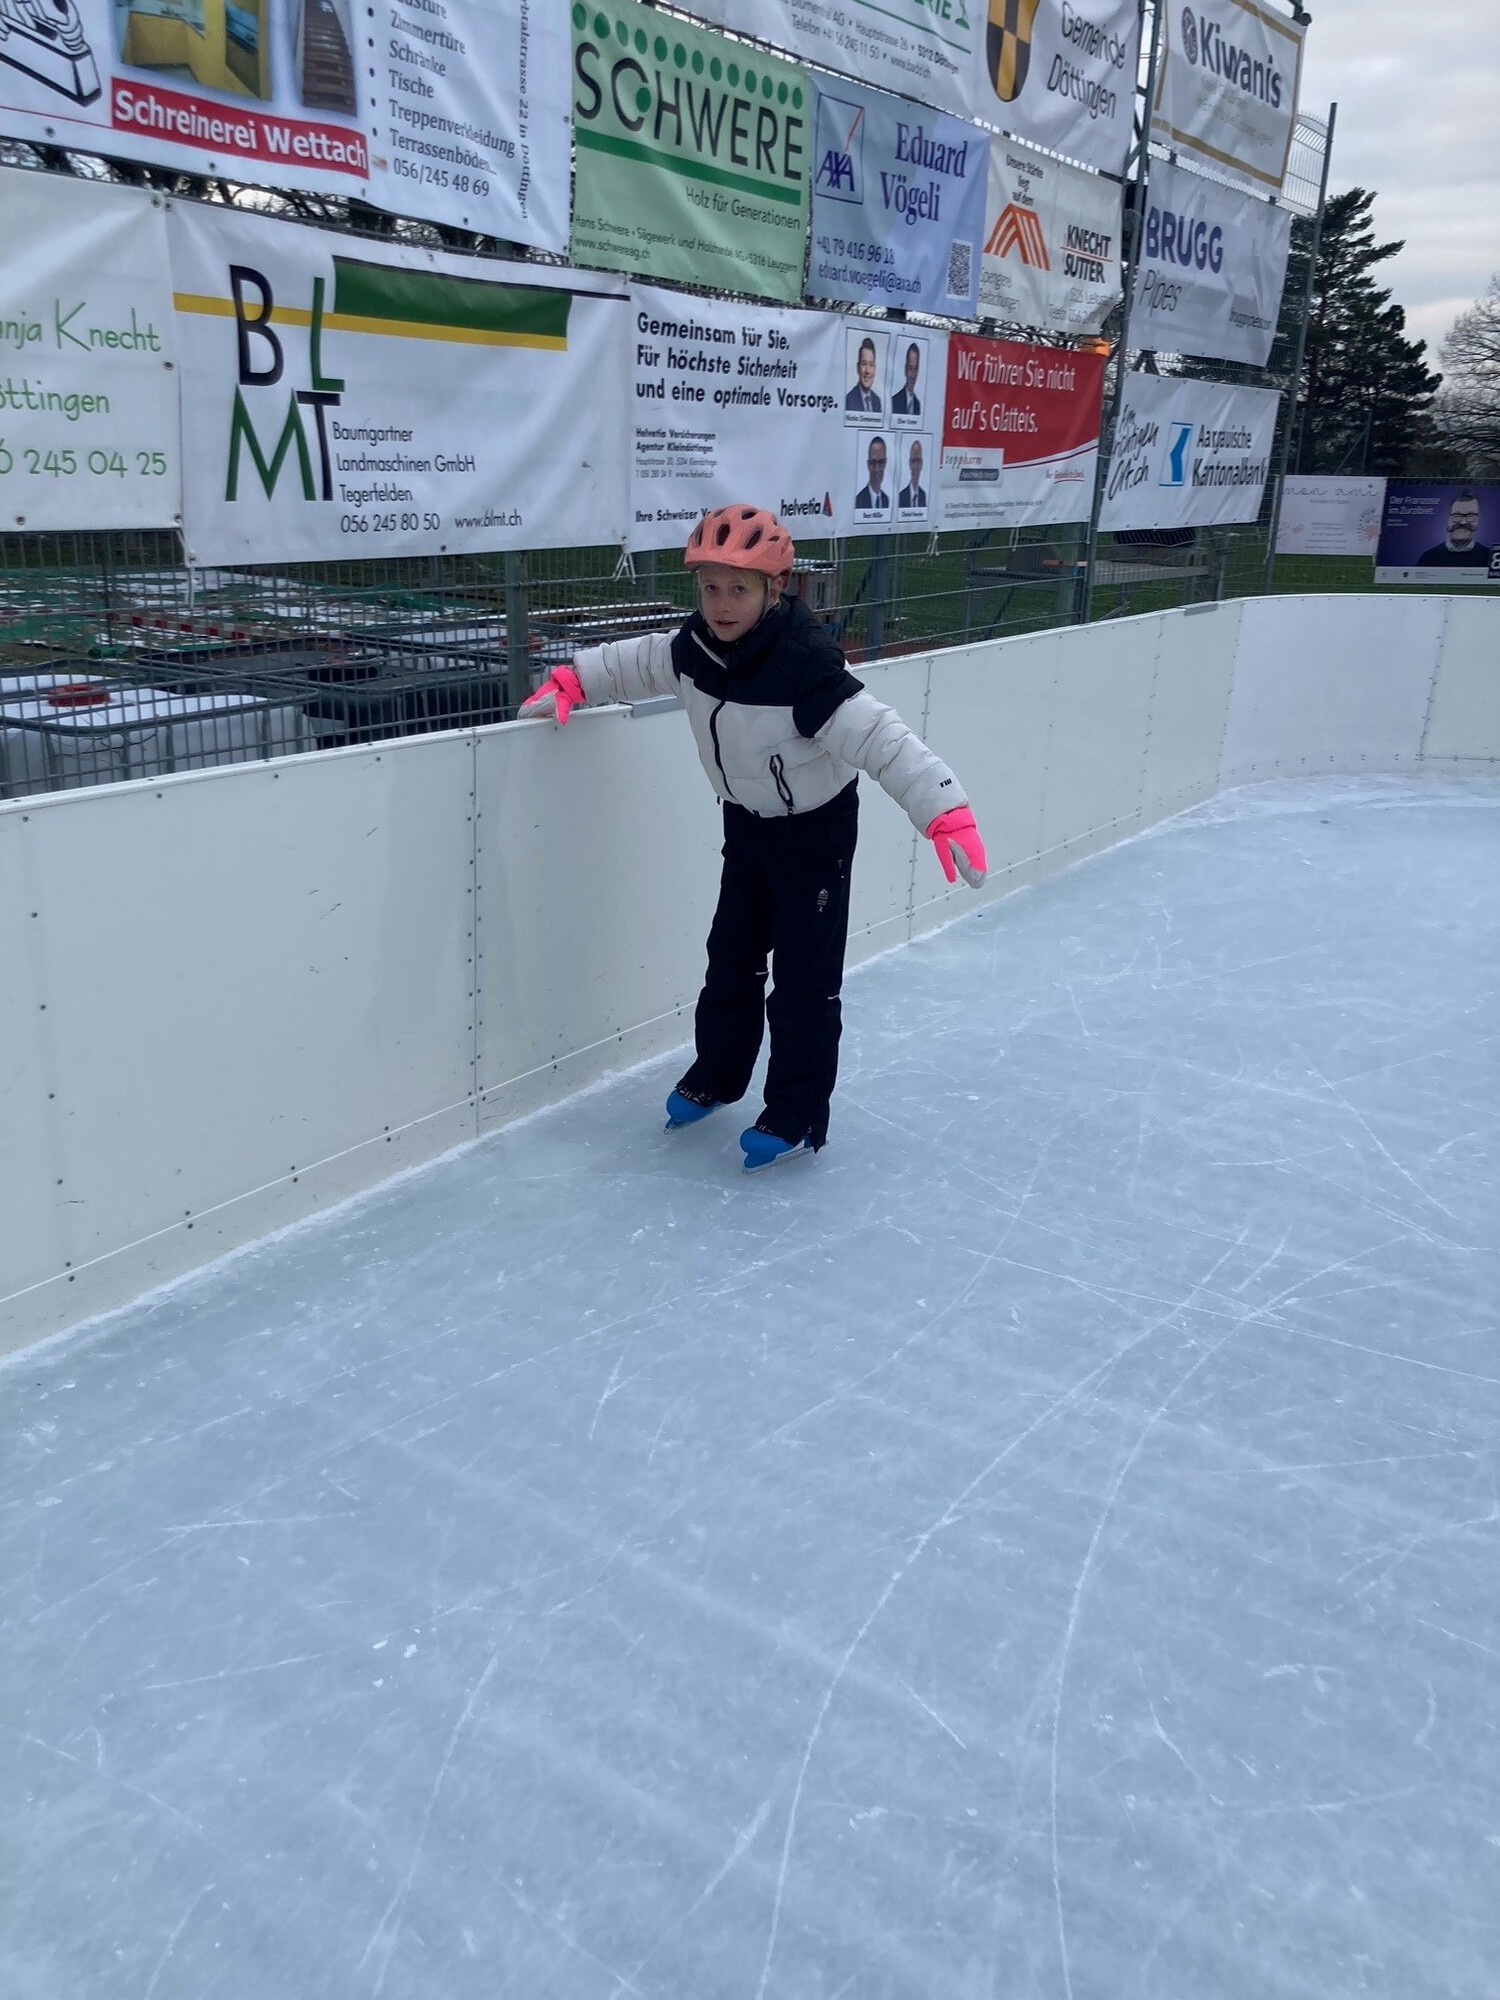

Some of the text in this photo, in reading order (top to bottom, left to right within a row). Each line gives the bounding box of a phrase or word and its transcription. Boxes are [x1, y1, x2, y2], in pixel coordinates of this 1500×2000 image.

[791, 13, 821, 37] Telefon
[1061, 1, 1127, 69] Gemeinde
[1200, 16, 1283, 109] Kiwanis
[388, 69, 435, 98] Tische
[1048, 54, 1118, 120] Döttingen
[519, 98, 529, 119] 22
[575, 42, 803, 181] SCHWERE
[115, 89, 368, 170] Schreinerei Wettach
[389, 99, 515, 159] Treppenverkleidung
[518, 124, 528, 138] in
[894, 122, 968, 178] Eduard
[393, 157, 489, 197] 056/245 48 69
[815, 150, 855, 191] AXA
[685, 186, 801, 230] Holz für Generationen
[880, 171, 941, 225] Vögeli
[597, 217, 630, 237] Schwere
[678, 237, 696, 249] und
[1066, 224, 1112, 257] KNECHT
[1146, 206, 1224, 274] BRUGG
[833, 238, 845, 257] 79
[846, 241, 865, 260] 416
[867, 244, 882, 262] 96
[1063, 254, 1106, 284] SUTTER
[0, 299, 162, 352] nja Knecht
[637, 312, 736, 344] Gemeinsam
[742, 326, 762, 347] für
[636, 344, 798, 379] Für höchste Sicherheit
[957, 350, 982, 381] Wir
[1025, 359, 1045, 388] Sie
[1047, 363, 1077, 392] nicht
[636, 378, 838, 413] und eine optimale Vorsorge.
[636, 427, 667, 438] Helvetia
[951, 401, 1038, 433] auf's Glatteis.
[332, 421, 414, 446] Baumgartner
[636, 441, 665, 453] Agentur
[23, 448, 77, 478] 245
[88, 450, 128, 478] 04
[136, 451, 167, 476] 25
[336, 452, 476, 473] Landmaschinen GmbH
[339, 482, 414, 508] Tegerfelden
[780, 499, 822, 518] helvetia
[1389, 496, 1404, 505] Der
[340, 508, 523, 533] 056 245 80 50 www.blmt.ch
[635, 510, 653, 522] Ihre
[656, 509, 698, 521] Schweizer
